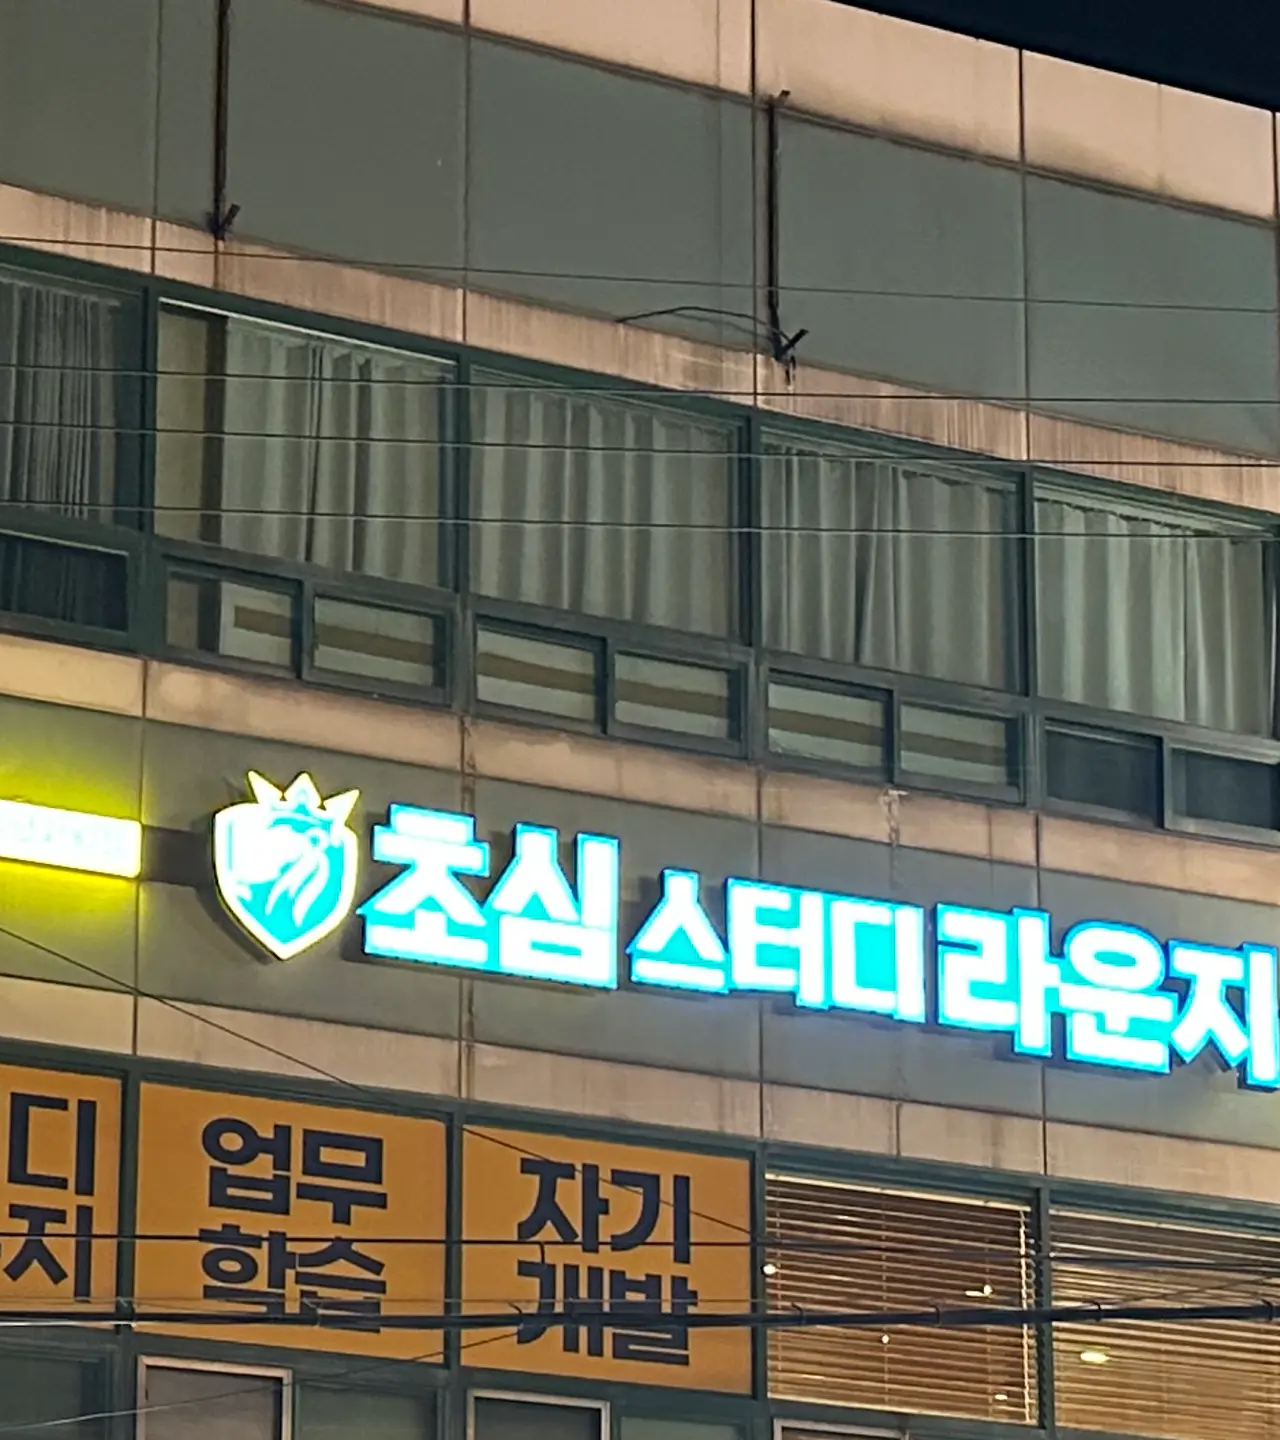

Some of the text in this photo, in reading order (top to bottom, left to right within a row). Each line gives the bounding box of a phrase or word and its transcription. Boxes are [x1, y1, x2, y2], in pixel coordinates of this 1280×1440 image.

[357, 802, 620, 990] 초심
[201, 1116, 388, 1225] 업무
[516, 1157, 691, 1264] 자기
[198, 1223, 388, 1334] 학습
[516, 1259, 699, 1366] 개발
